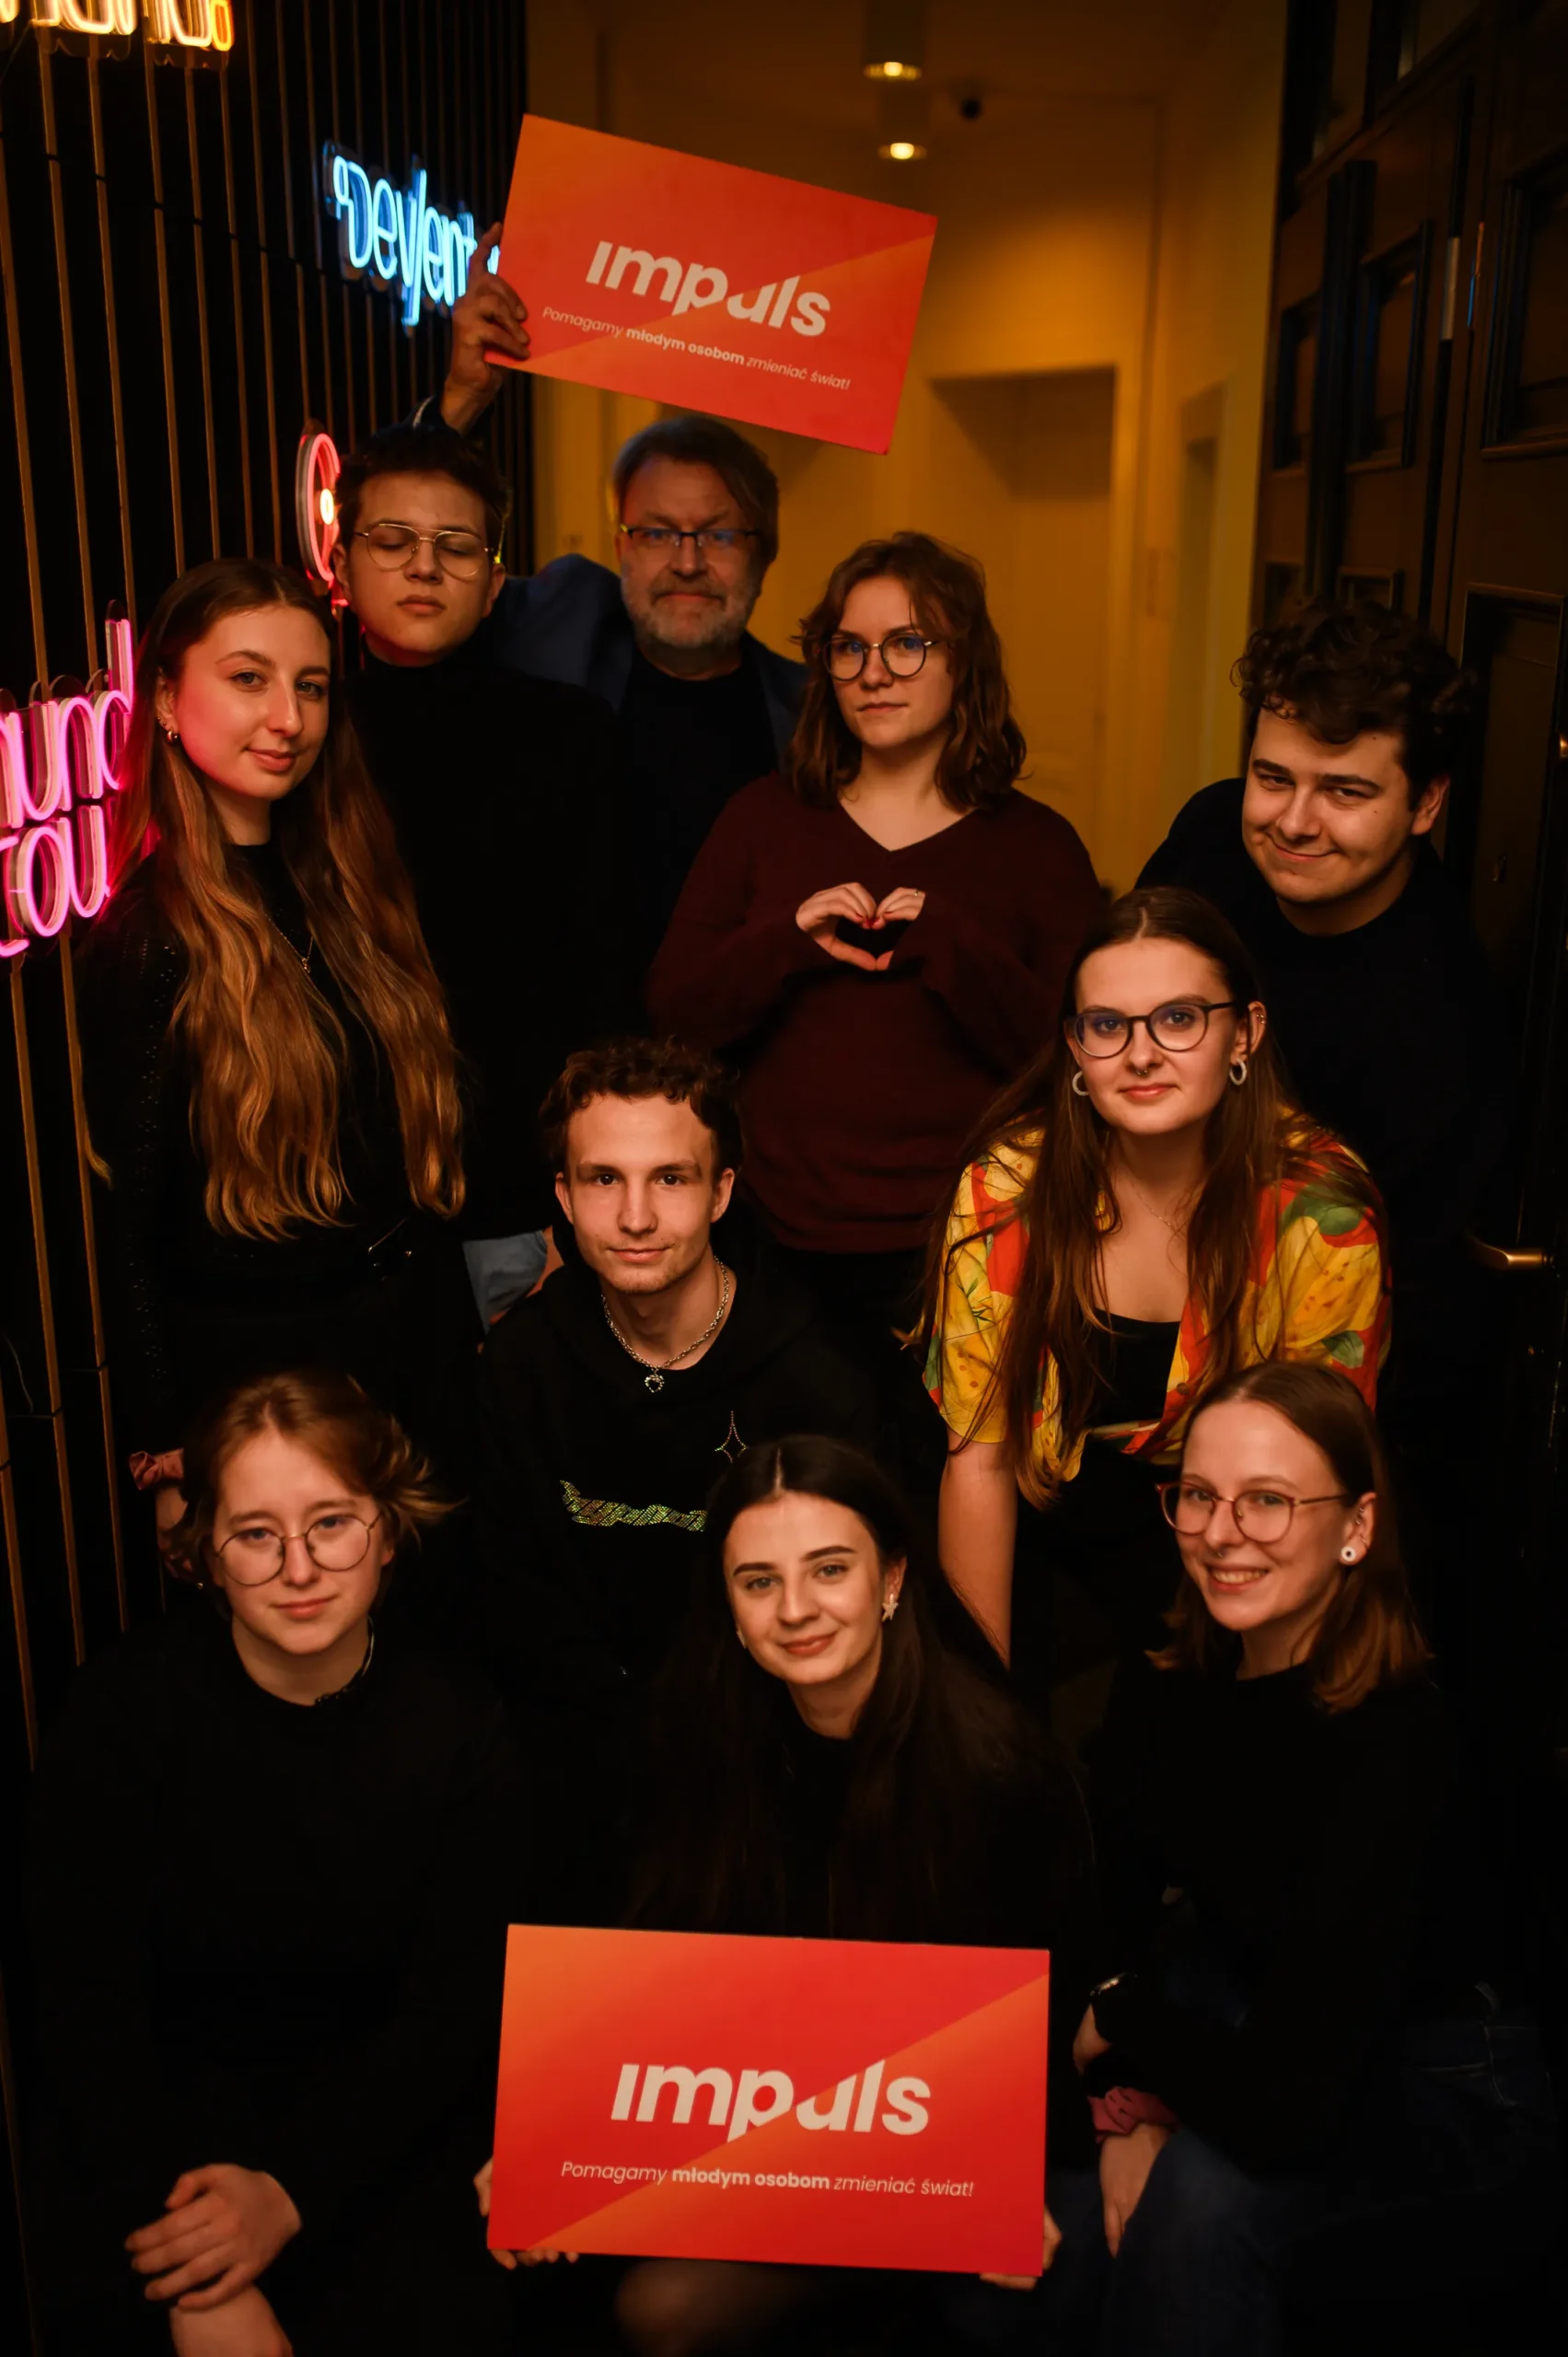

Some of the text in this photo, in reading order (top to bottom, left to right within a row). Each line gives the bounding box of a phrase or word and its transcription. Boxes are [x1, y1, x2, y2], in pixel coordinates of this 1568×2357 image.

[542, 307, 851, 390] Pomagamy młodym osobom zmieniać świat!
[561, 2161, 974, 2198] Pomagamy młodym osobom zmieniać świat!
